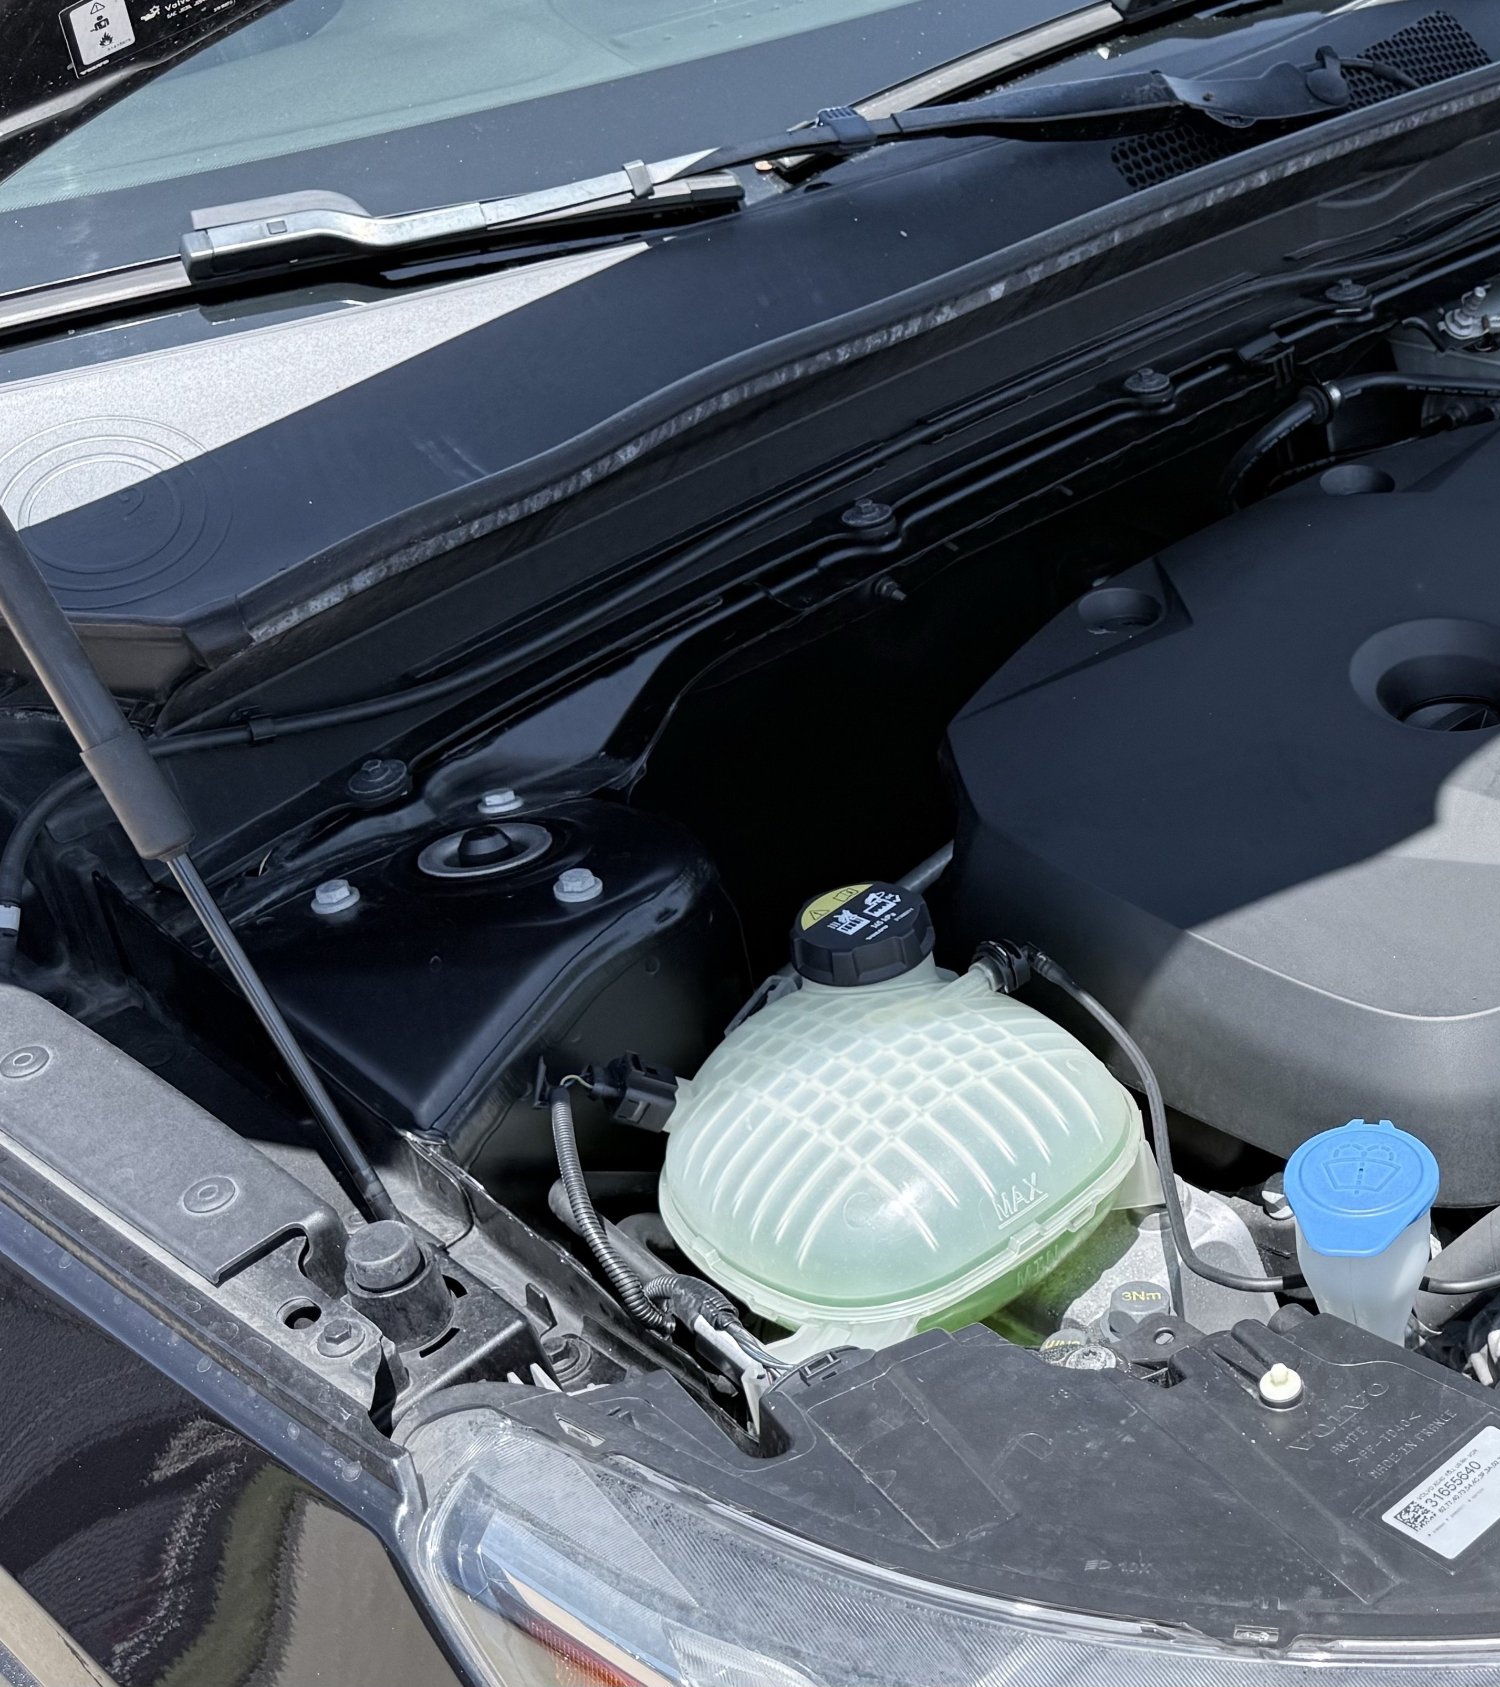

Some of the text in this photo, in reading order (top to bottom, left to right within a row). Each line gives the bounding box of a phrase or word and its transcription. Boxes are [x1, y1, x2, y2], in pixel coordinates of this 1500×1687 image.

[165, 0, 191, 11] Volv
[992, 1172, 1044, 1221] MAX
[1017, 1244, 1059, 1286] MIN
[1285, 1382, 1390, 1451] VOLVO
[1368, 1452, 1401, 1480] MADE
[1415, 1408, 1458, 1442] FRANCE
[1424, 1460, 1482, 1508] 31655640
